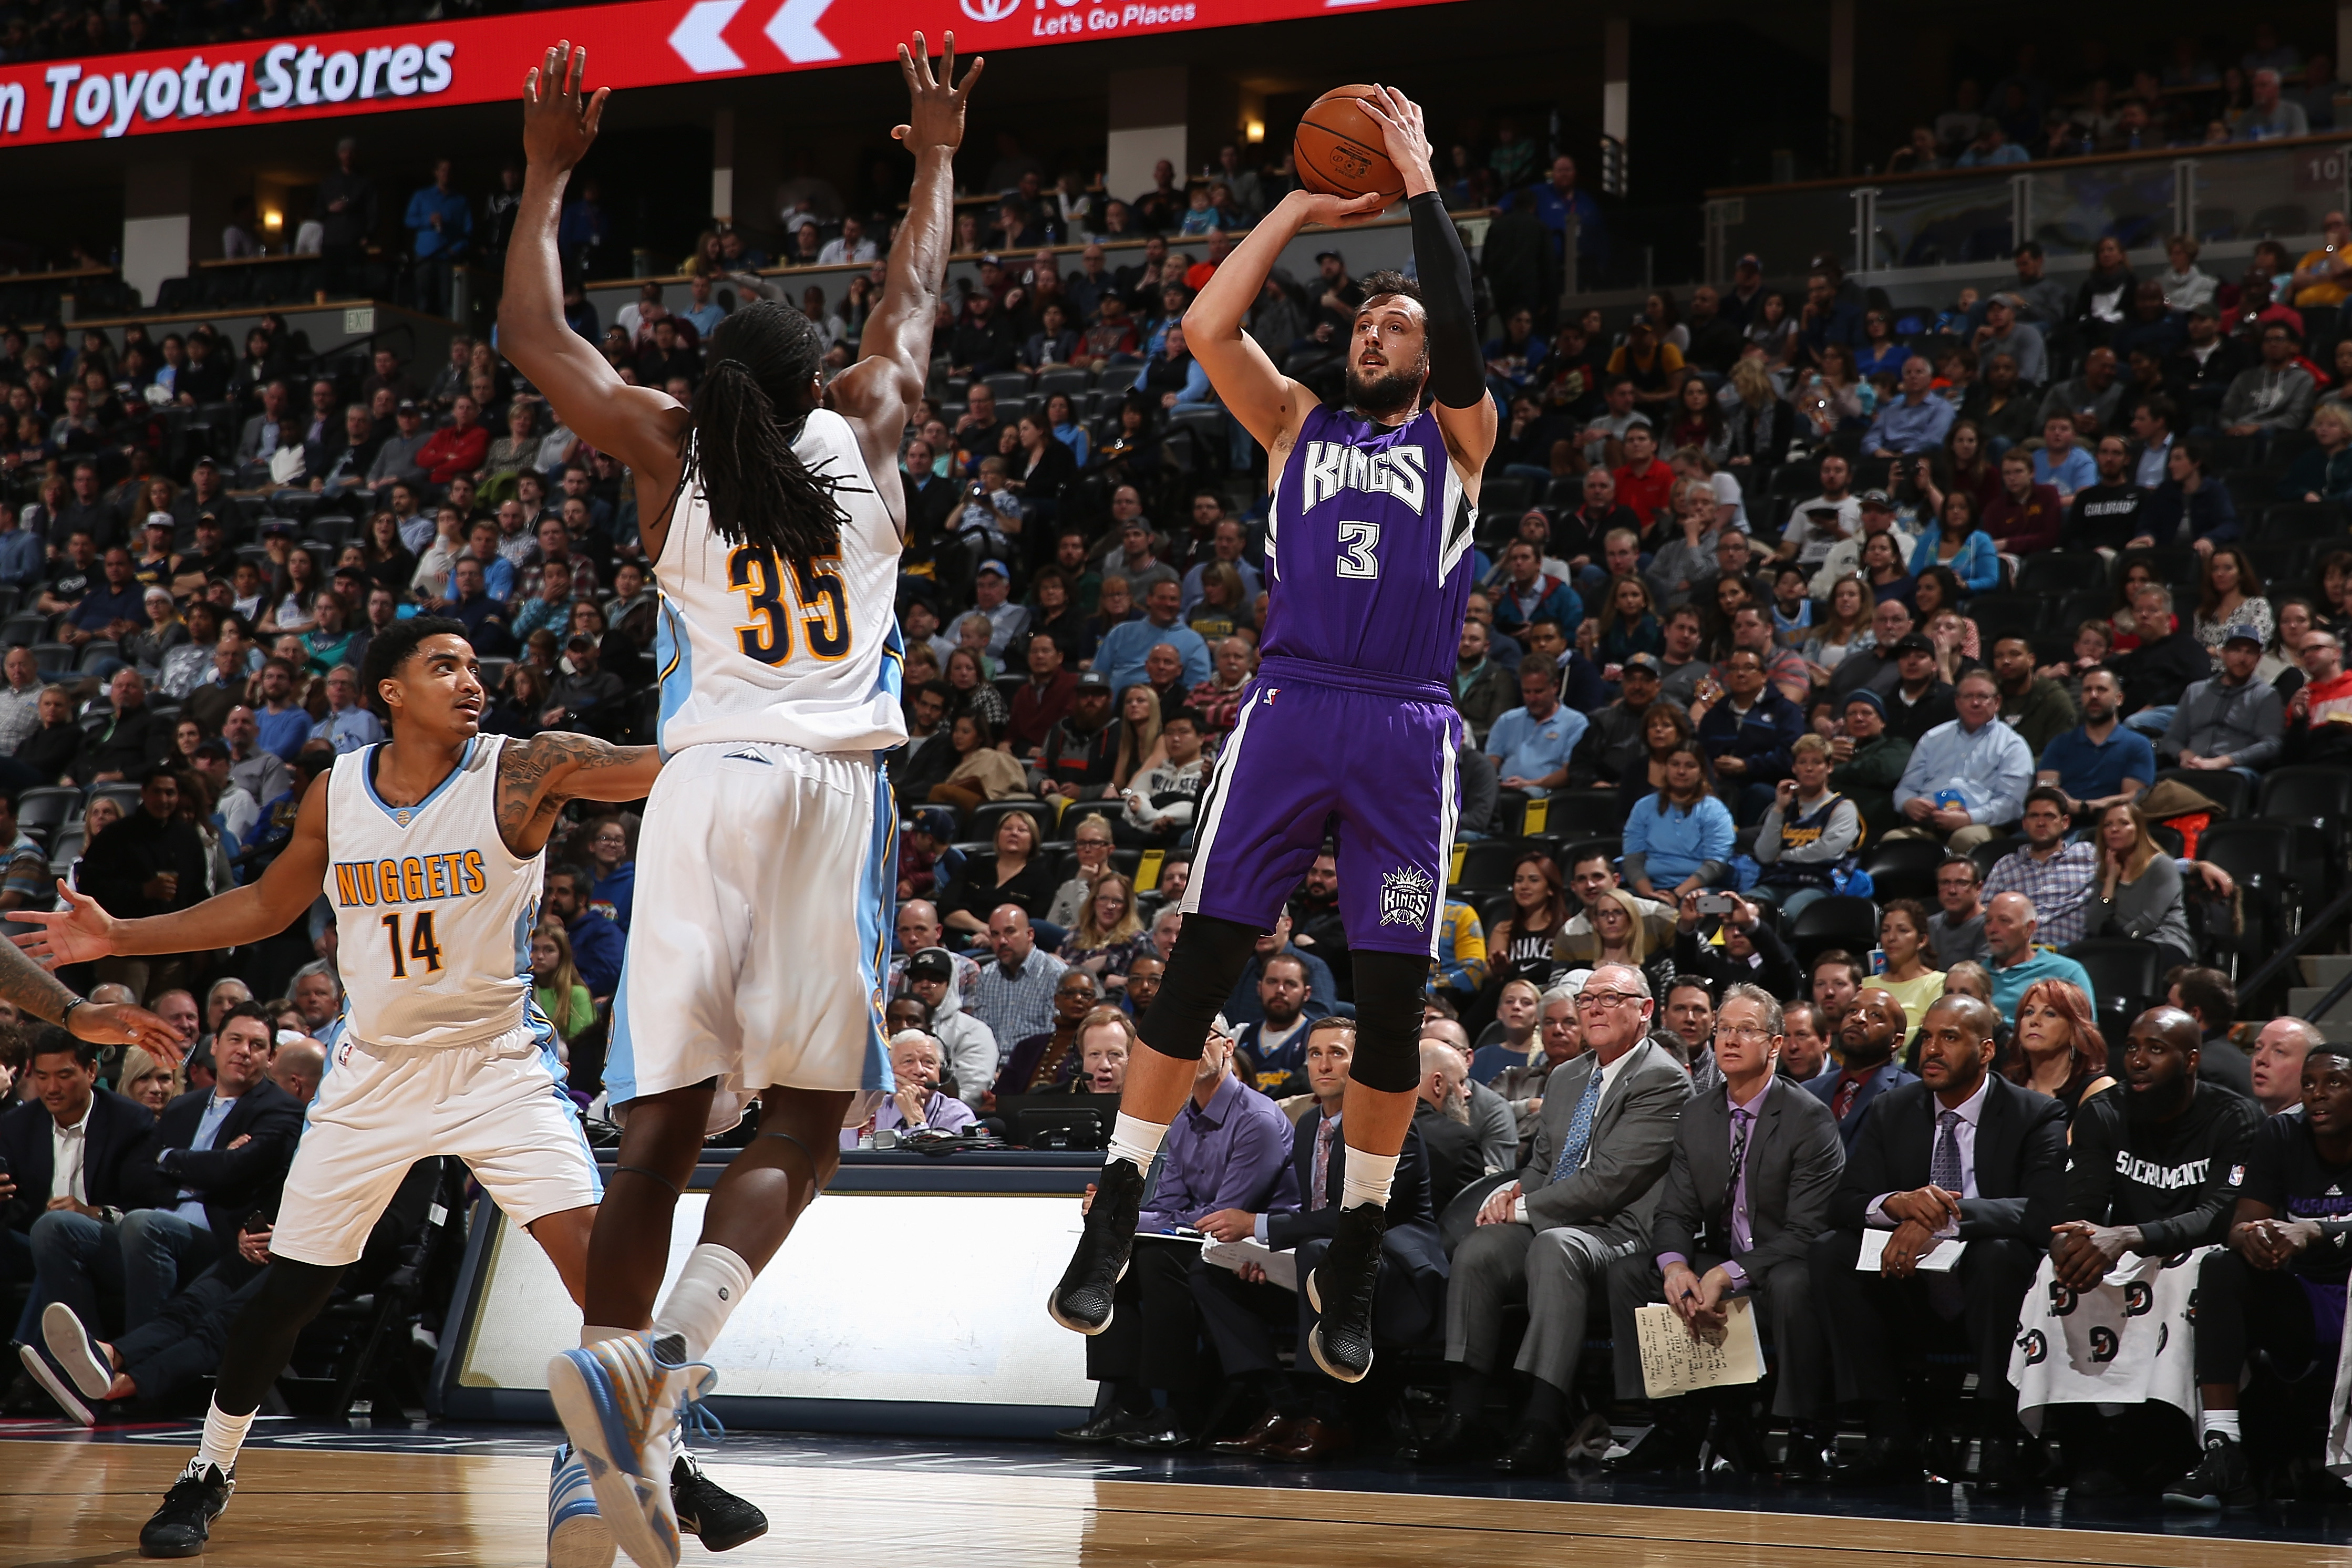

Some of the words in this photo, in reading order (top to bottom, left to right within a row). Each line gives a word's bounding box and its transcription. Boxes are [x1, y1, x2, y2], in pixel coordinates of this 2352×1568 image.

[1032, 12, 1082, 37] Let's
[1087, 8, 1119, 31] Go
[1122, 3, 1196, 27] Places
[45, 56, 245, 138] Toyota
[256, 40, 455, 109] Stores
[348, 311, 372, 331] EXIT
[1302, 441, 1427, 516] KINGS
[1336, 521, 1380, 580] 3
[726, 543, 852, 668] 35
[333, 848, 486, 907] NUGGETS
[1384, 890, 1428, 917] KINGS
[1391, 884, 1422, 894] SACRAMENTO
[380, 910, 443, 979] 14
[1509, 937, 1554, 962] NIKE
